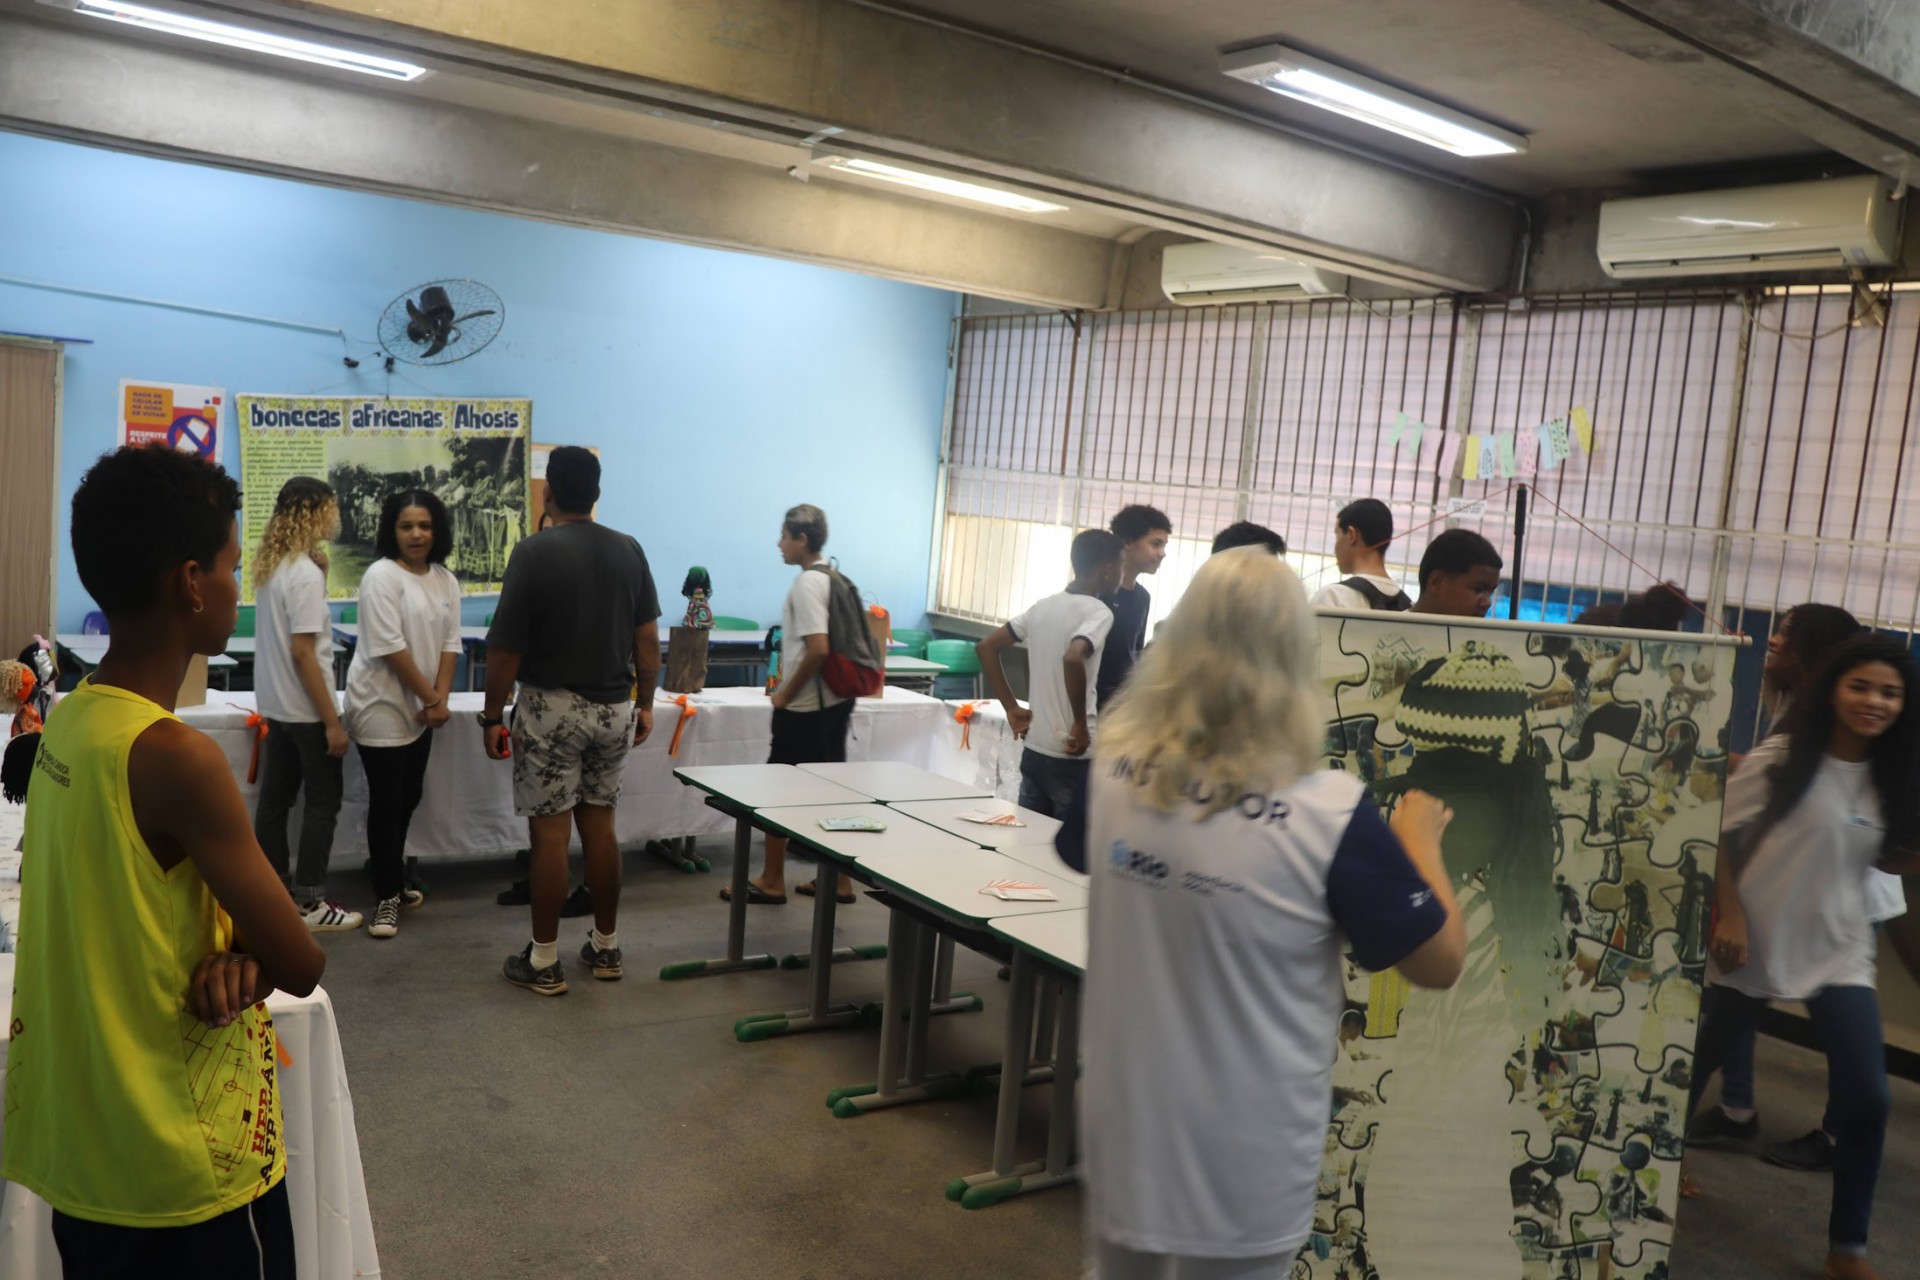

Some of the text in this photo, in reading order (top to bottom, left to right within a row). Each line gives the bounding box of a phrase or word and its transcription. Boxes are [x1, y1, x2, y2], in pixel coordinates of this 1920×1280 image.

[251, 403, 341, 428] bonecas
[454, 404, 519, 429] Ahosis
[130, 430, 167, 440] RESPEITE
